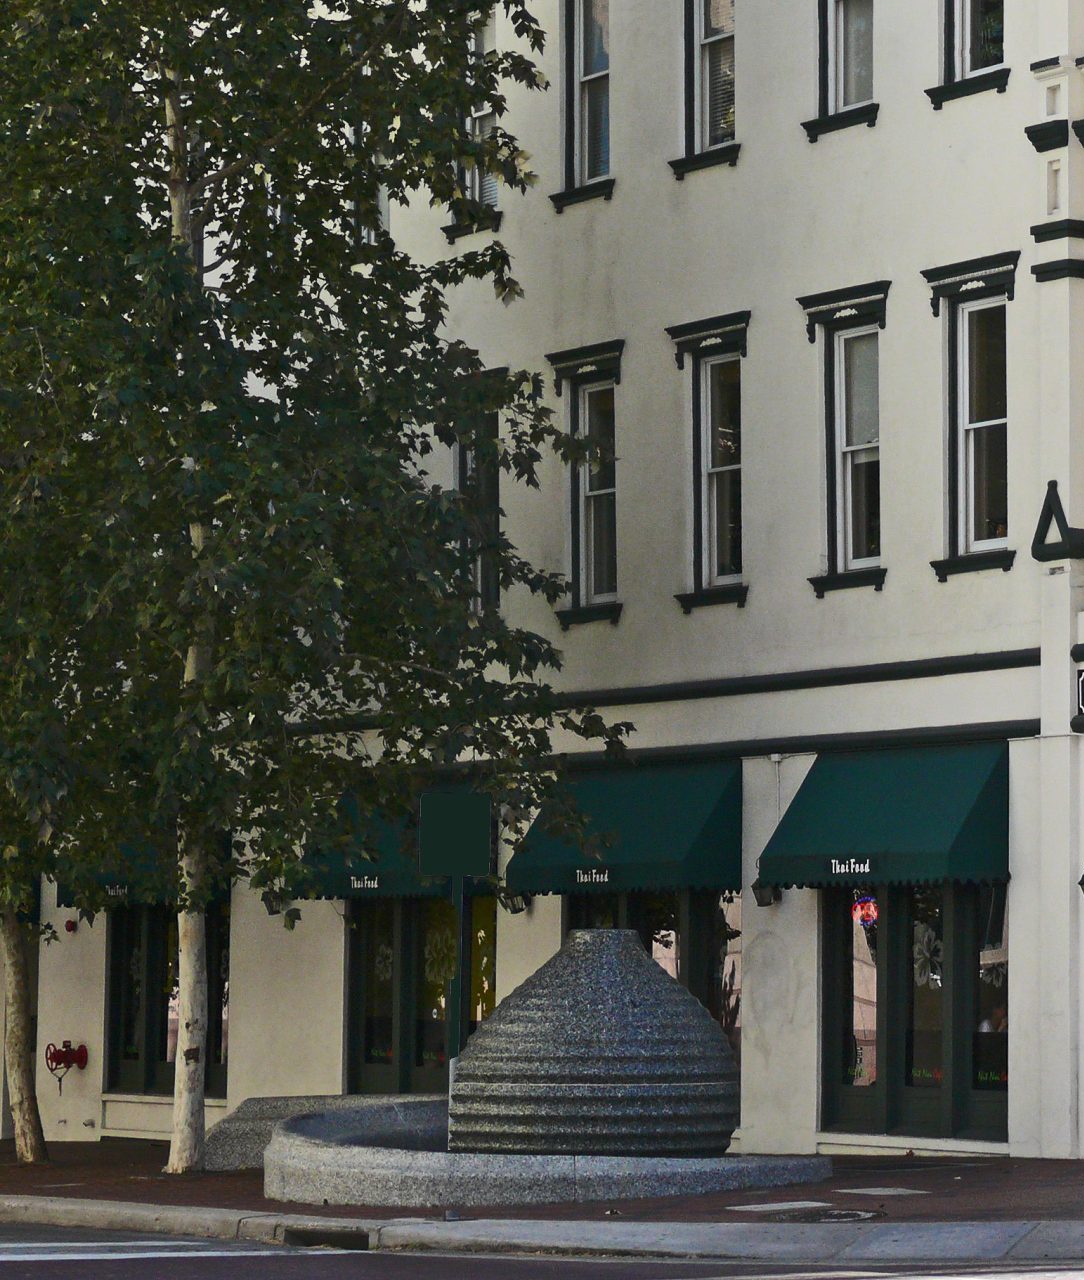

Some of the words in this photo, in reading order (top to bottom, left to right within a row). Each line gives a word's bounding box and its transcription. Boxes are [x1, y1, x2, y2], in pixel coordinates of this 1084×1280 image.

[831, 859, 849, 874] Thai
[850, 858, 870, 873] Food
[350, 875, 363, 888] Thai
[364, 875, 379, 888] Food
[576, 869, 591, 883] Thai
[592, 869, 609, 883] Food
